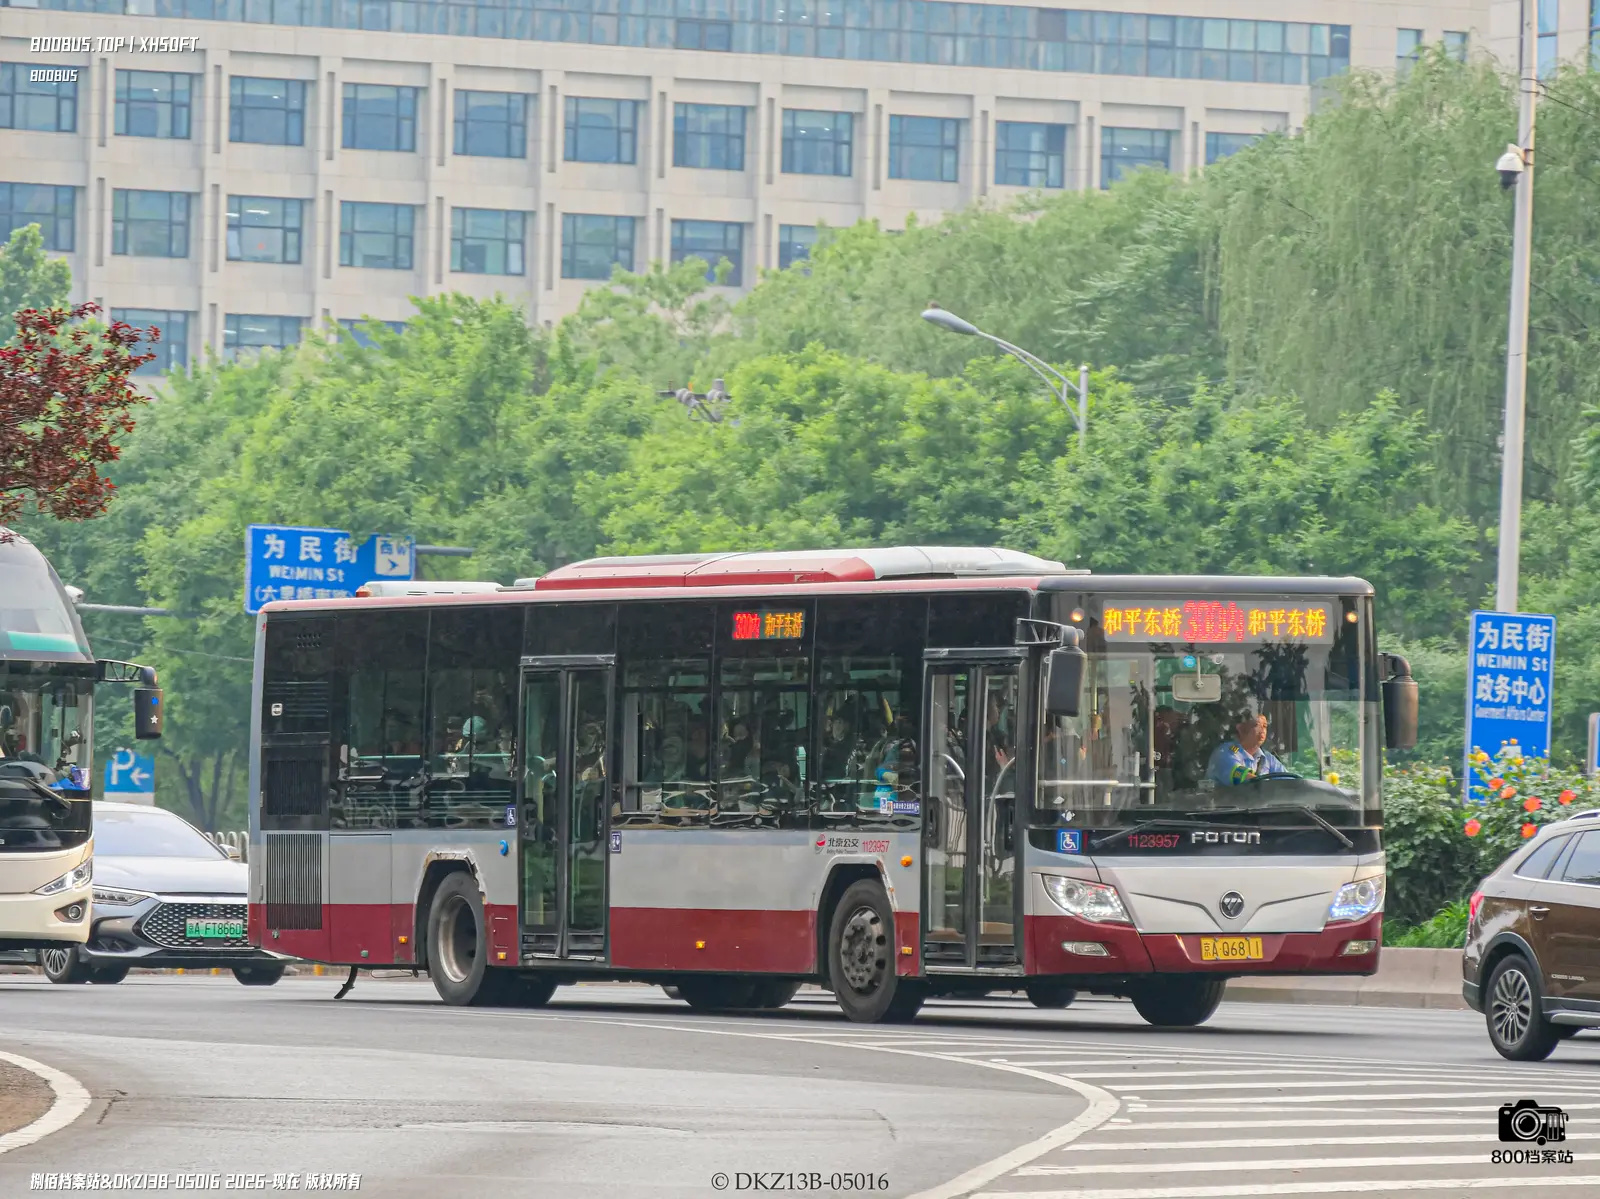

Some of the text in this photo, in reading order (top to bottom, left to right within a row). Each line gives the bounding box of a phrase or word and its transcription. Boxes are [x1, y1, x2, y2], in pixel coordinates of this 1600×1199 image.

[262, 533, 359, 564] 为民街
[269, 564, 345, 583] WEIMIN St
[765, 611, 804, 639] 和平东桥
[1103, 600, 1327, 642] 和平东桥 300内 和平东桥
[1477, 620, 1550, 653] 为民街
[1476, 652, 1549, 672] WEIMIN St
[1475, 673, 1546, 705] 政务中心
[828, 837, 859, 848] 北京公交
[862, 840, 890, 853] 1123957
[1127, 834, 1180, 849] 1123957
[1191, 831, 1261, 845] FOTON
